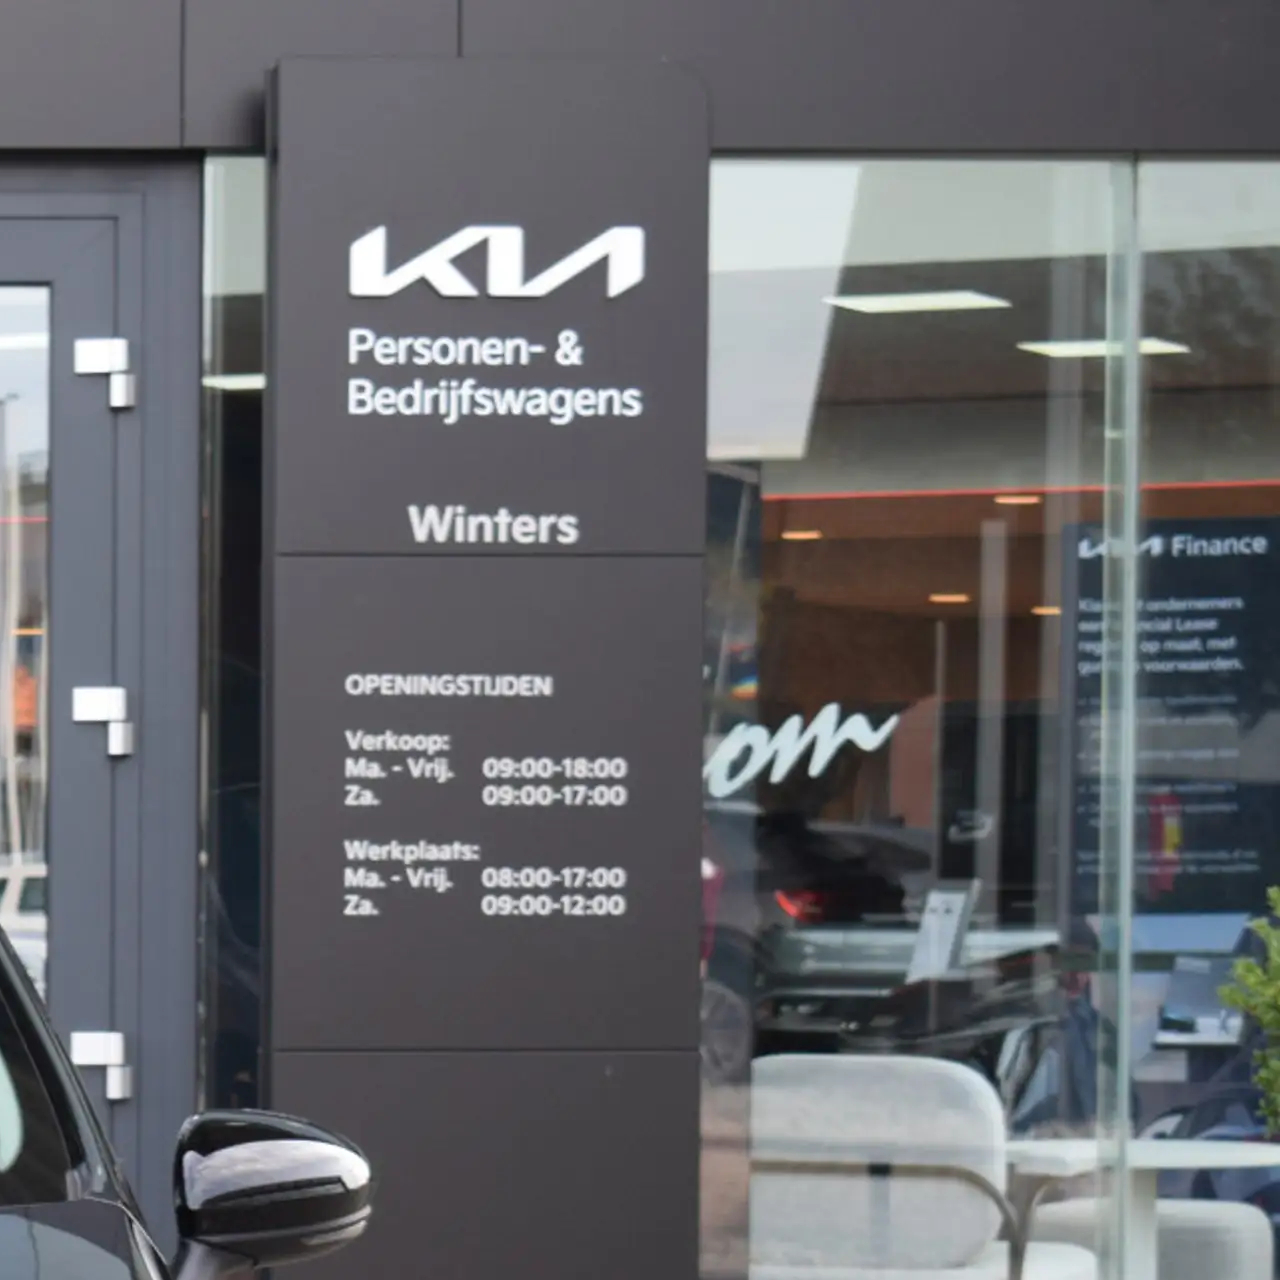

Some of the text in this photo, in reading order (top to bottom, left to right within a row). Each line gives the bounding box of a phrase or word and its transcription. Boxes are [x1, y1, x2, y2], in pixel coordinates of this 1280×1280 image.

[349, 225, 645, 298] KIA
[348, 328, 584, 366] Personen- &
[348, 378, 643, 426] Bedrijfswagens
[408, 505, 579, 544] Winters
[1171, 534, 1268, 557] Finance
[345, 674, 553, 696] OPENINGSTIJDEN
[344, 730, 451, 755] Verkoop:
[344, 758, 387, 779] Ma.
[406, 757, 455, 783] Vrij.
[482, 758, 627, 778] 09:00-18:00
[344, 785, 627, 806] Za. 09:00-17:00
[344, 840, 480, 864] Werkplaats:
[344, 867, 386, 888] Ma.
[406, 867, 454, 893] Vrij.
[482, 867, 626, 888] 08:00-17:00
[343, 894, 626, 915] Za. 09:00-12:00
